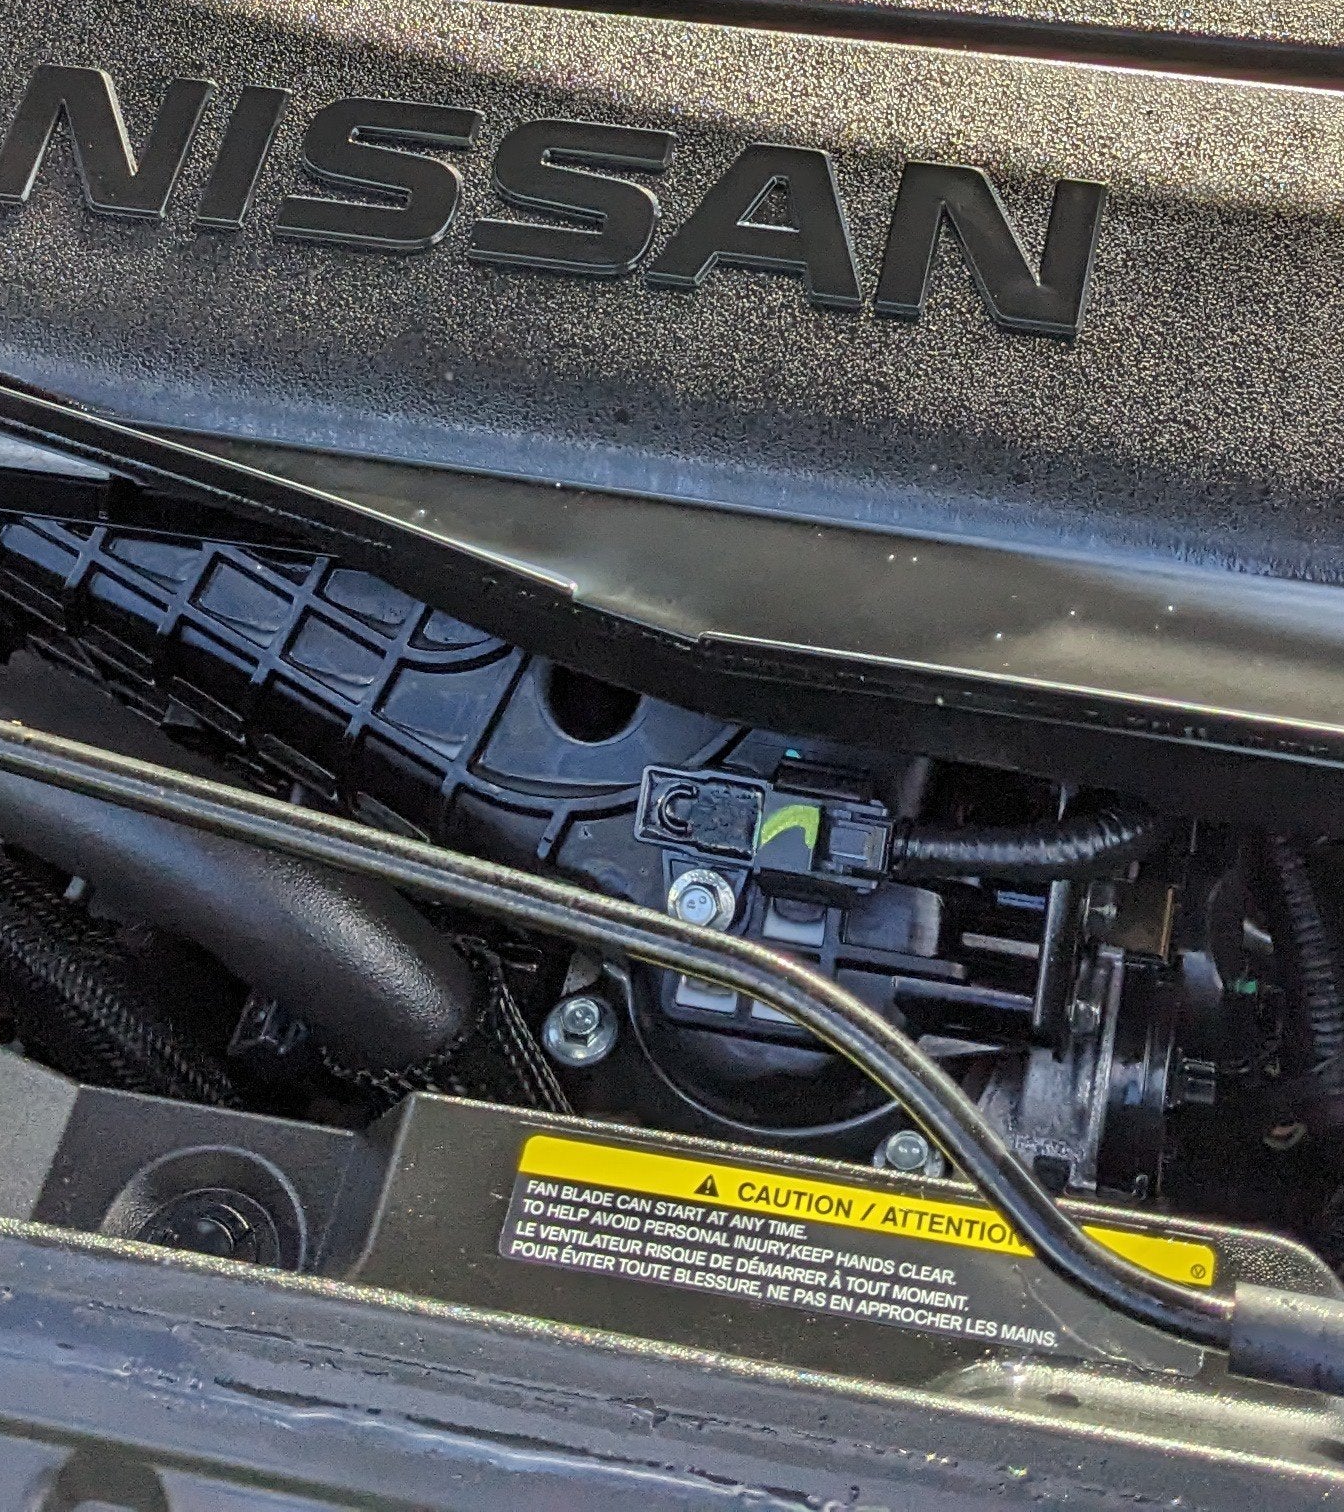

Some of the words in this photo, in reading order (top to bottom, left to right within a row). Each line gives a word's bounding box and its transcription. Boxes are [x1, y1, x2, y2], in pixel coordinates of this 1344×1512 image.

[523, 1198, 544, 1216] TO
[547, 1203, 590, 1225] HELP
[591, 1210, 641, 1231] AVOID
[644, 1218, 731, 1246] PERSONAL
[836, 1251, 895, 1276] HANDS
[899, 1262, 957, 1286] CLEAR.
[527, 1179, 559, 1198] FAN
[561, 1185, 614, 1208] BLADE
[617, 1194, 652, 1214] CAN
[655, 1200, 705, 1222] START
[707, 1210, 729, 1226] AT
[730, 1214, 766, 1232] ANY
[768, 1219, 808, 1240] TIME.
[738, 1181, 853, 1219] CAUTION
[860, 1202, 876, 1222] /
[510, 1239, 558, 1262] POUR
[560, 1244, 616, 1271] ÉVITER
[618, 1257, 672, 1281] TOUTE
[674, 1267, 764, 1299] BLESSURE,
[766, 1284, 791, 1301] NE
[793, 1288, 827, 1308] PAS
[829, 1294, 854, 1312] EN
[855, 1298, 963, 1332] APPROCHER
[965, 1317, 998, 1338] LES
[1000, 1324, 1060, 1348] MAINS.
[516, 1220, 535, 1238] LE
[539, 1224, 643, 1256] VENTILATEUR
[645, 1243, 707, 1267] RISQUE
[710, 1253, 737, 1271] DE
[736, 1256, 829, 1288] DÉMARRER
[829, 1269, 843, 1289] À
[846, 1275, 890, 1296] TOUT
[892, 1285, 970, 1312] MOMENT.
